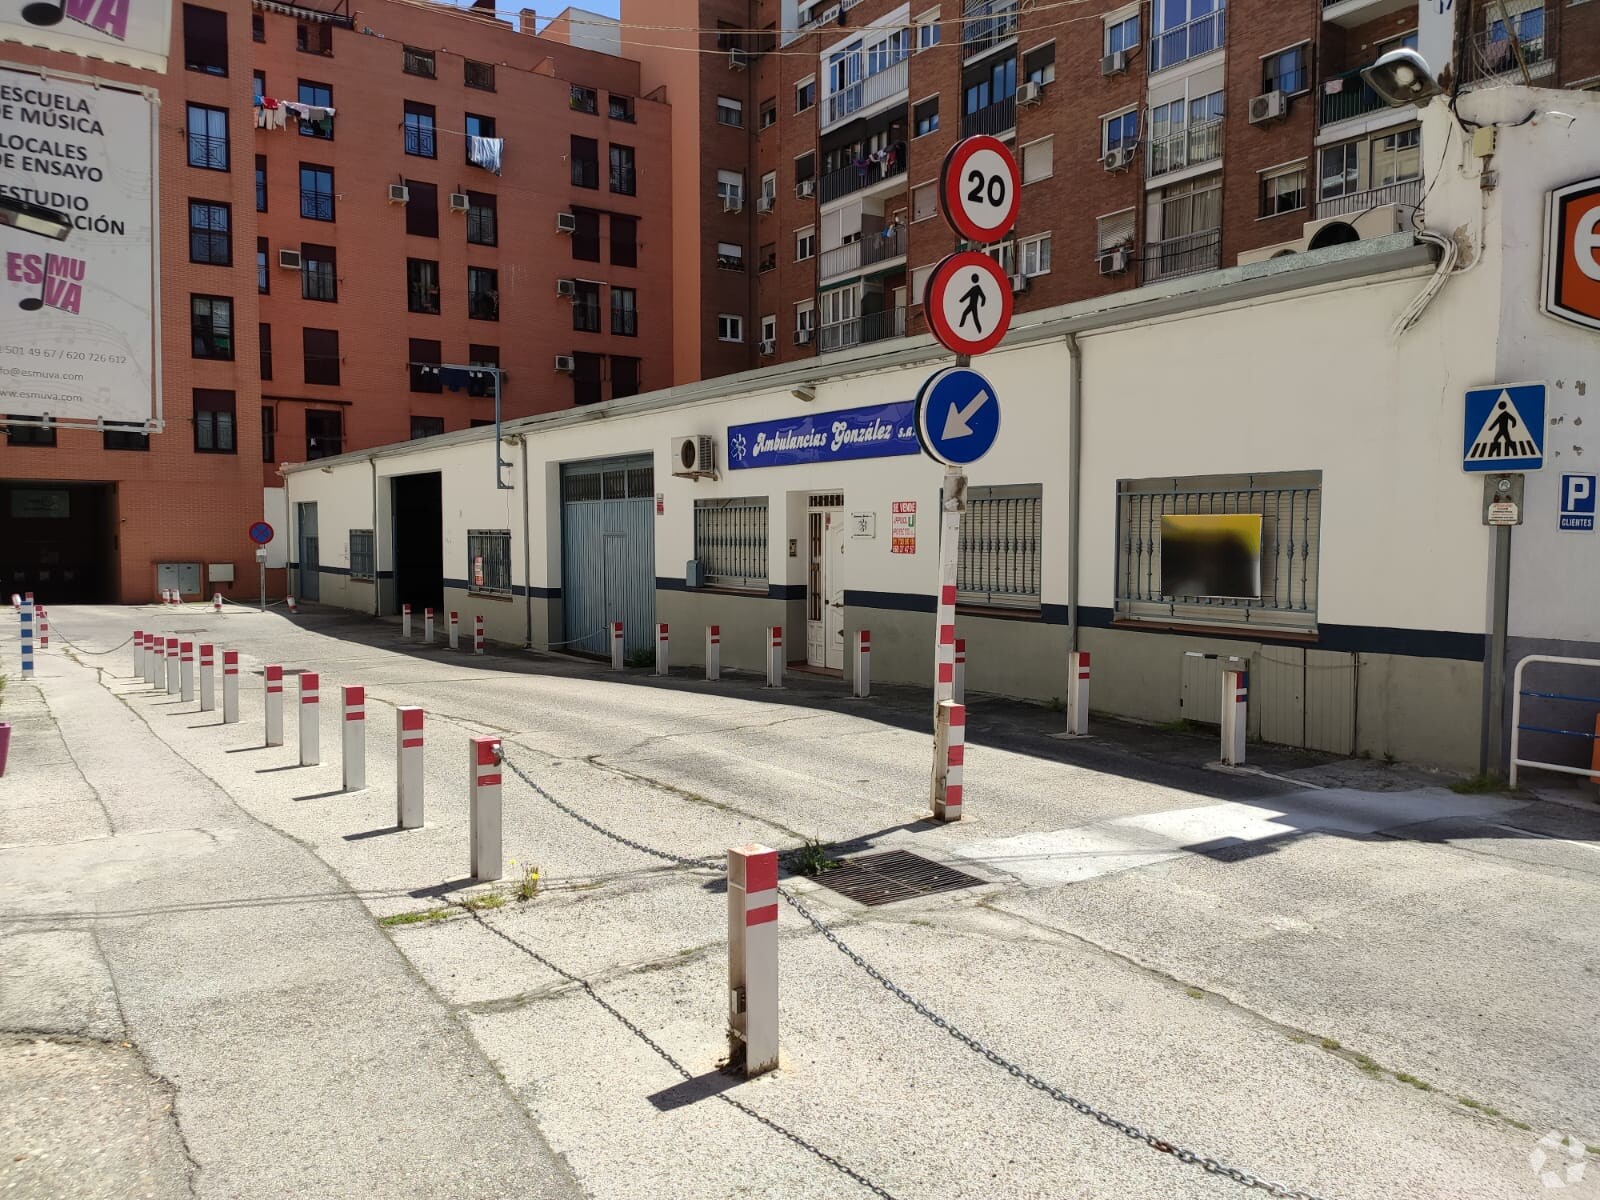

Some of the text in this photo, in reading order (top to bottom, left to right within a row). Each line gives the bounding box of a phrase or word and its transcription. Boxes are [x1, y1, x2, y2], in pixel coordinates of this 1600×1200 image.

[0, 84, 91, 115] ESCUELA
[21, 107, 105, 136] MÚSICA
[0, 132, 88, 162] LOCALES
[22, 156, 104, 183] ENSAYO
[967, 169, 1006, 208] 20
[45, 275, 82, 315] VA
[5, 345, 24, 356] 501
[28, 348, 41, 357] 49
[43, 349, 57, 358] 67
[66, 351, 86, 361] 620
[89, 353, 106, 363] 726
[108, 355, 127, 364] 612
[753, 428, 828, 458] Ambulancias
[830, 418, 893, 452] González
[1567, 476, 1590, 511] P
[1561, 518, 1593, 528] CLIENTES
